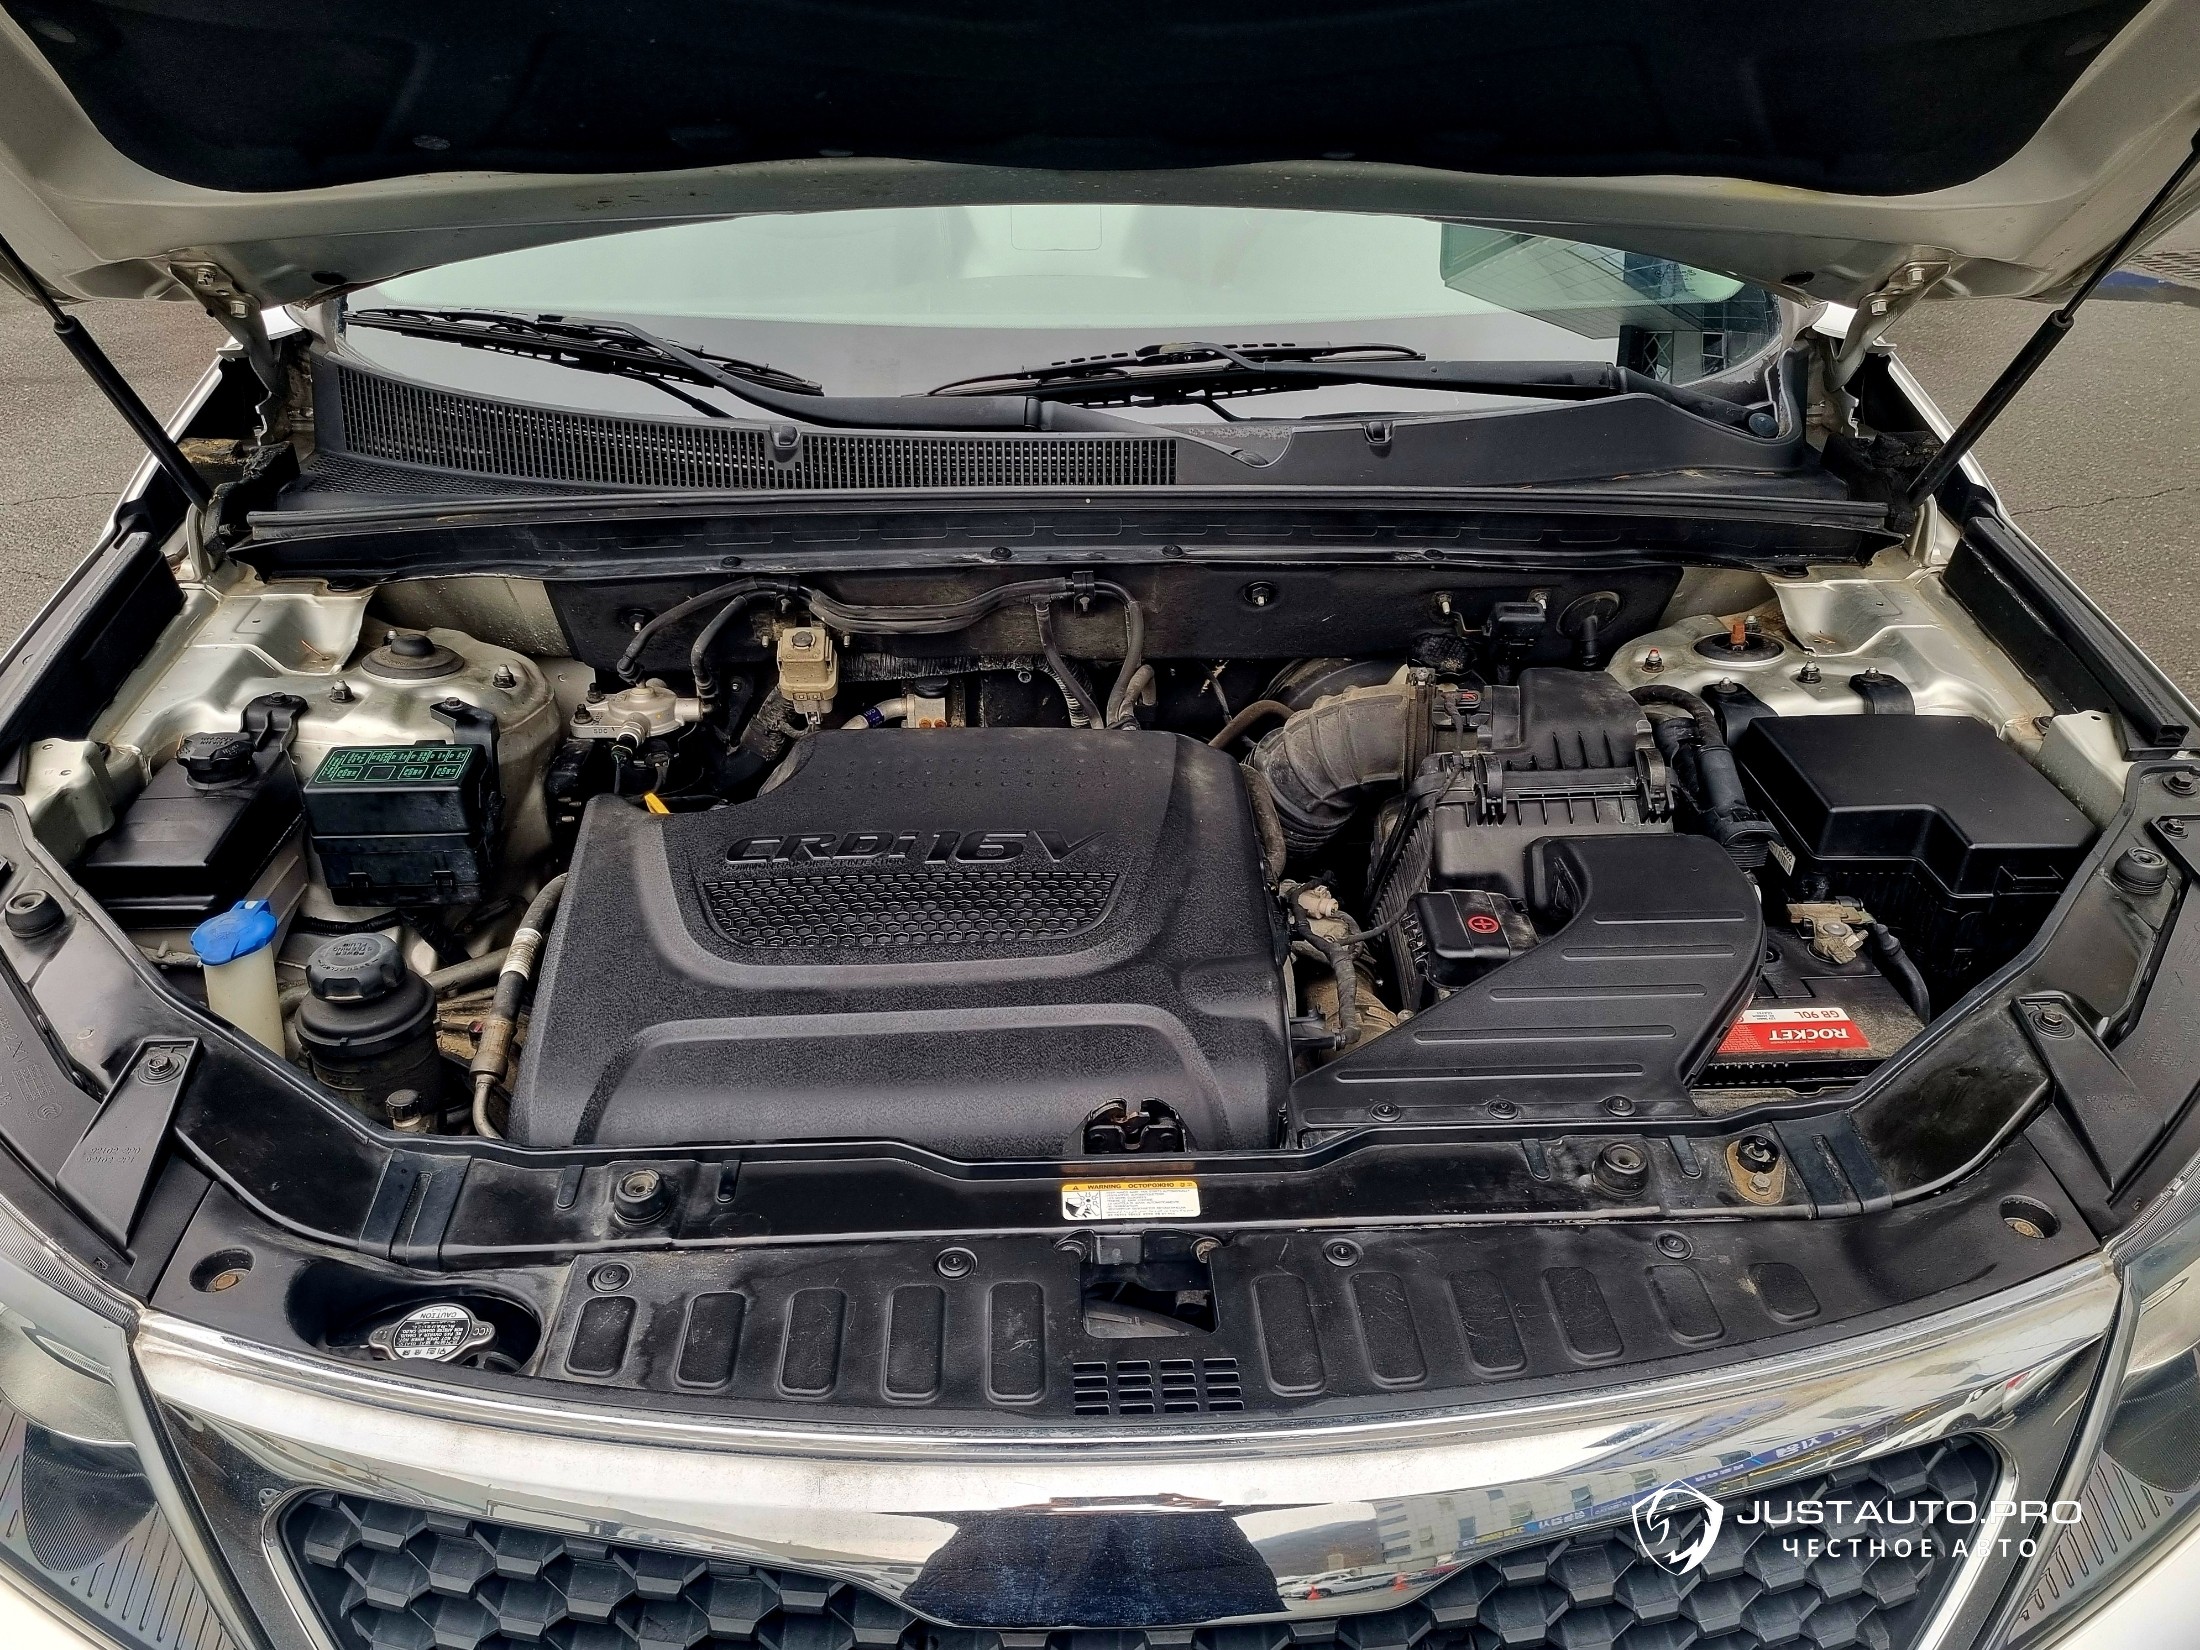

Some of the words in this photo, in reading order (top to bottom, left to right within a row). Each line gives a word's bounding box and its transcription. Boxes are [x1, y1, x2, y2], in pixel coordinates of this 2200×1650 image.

[925, 829, 1109, 865] 16V
[1794, 1010, 1819, 1019] 90L
[1821, 1010, 1840, 1019] GB
[1769, 1027, 1850, 1041] ROCKET
[472, 1327, 492, 1336] HCC
